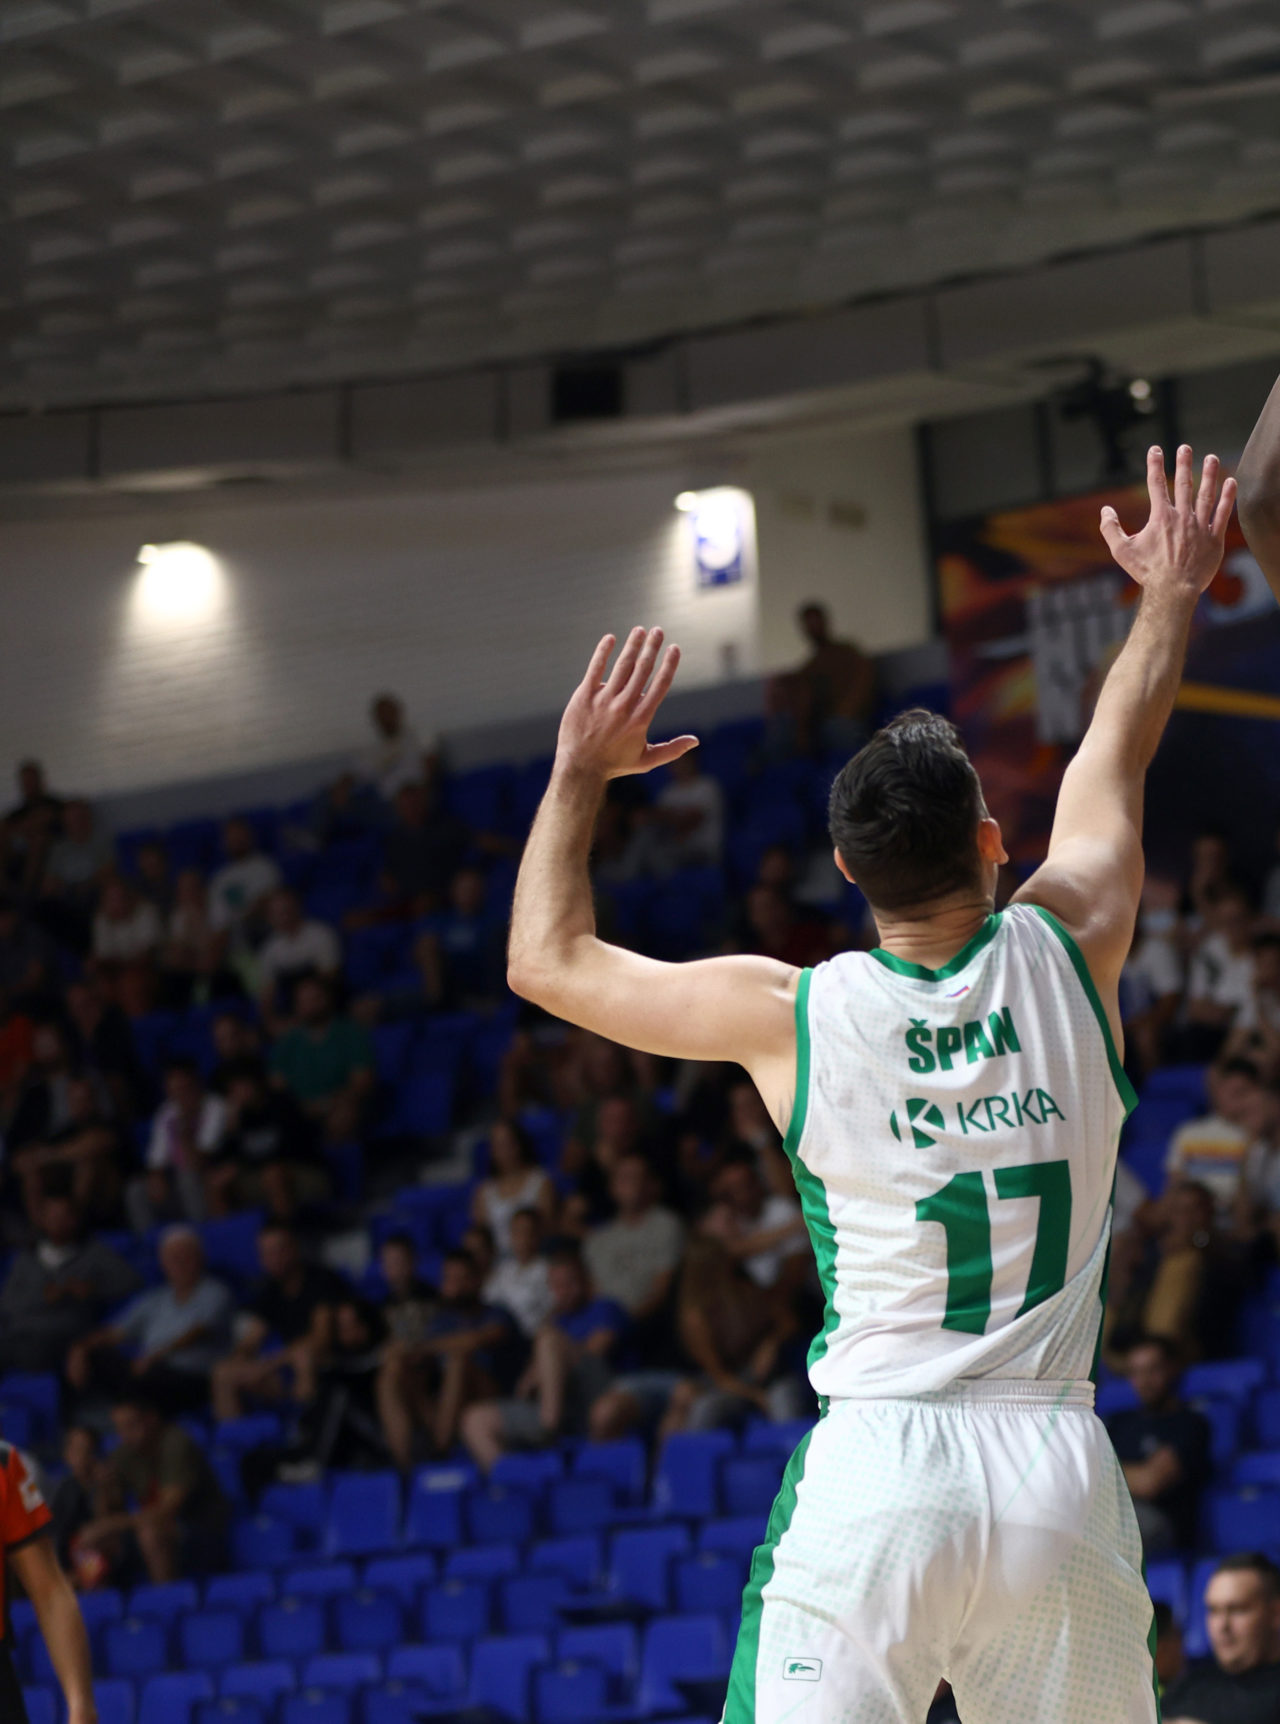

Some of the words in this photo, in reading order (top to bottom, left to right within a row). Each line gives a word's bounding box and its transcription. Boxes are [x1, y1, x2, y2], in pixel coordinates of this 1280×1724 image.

[905, 1007, 1022, 1074] ŠPAN
[956, 1088, 1066, 1134] KRKA
[915, 1159, 1073, 1336] 17
